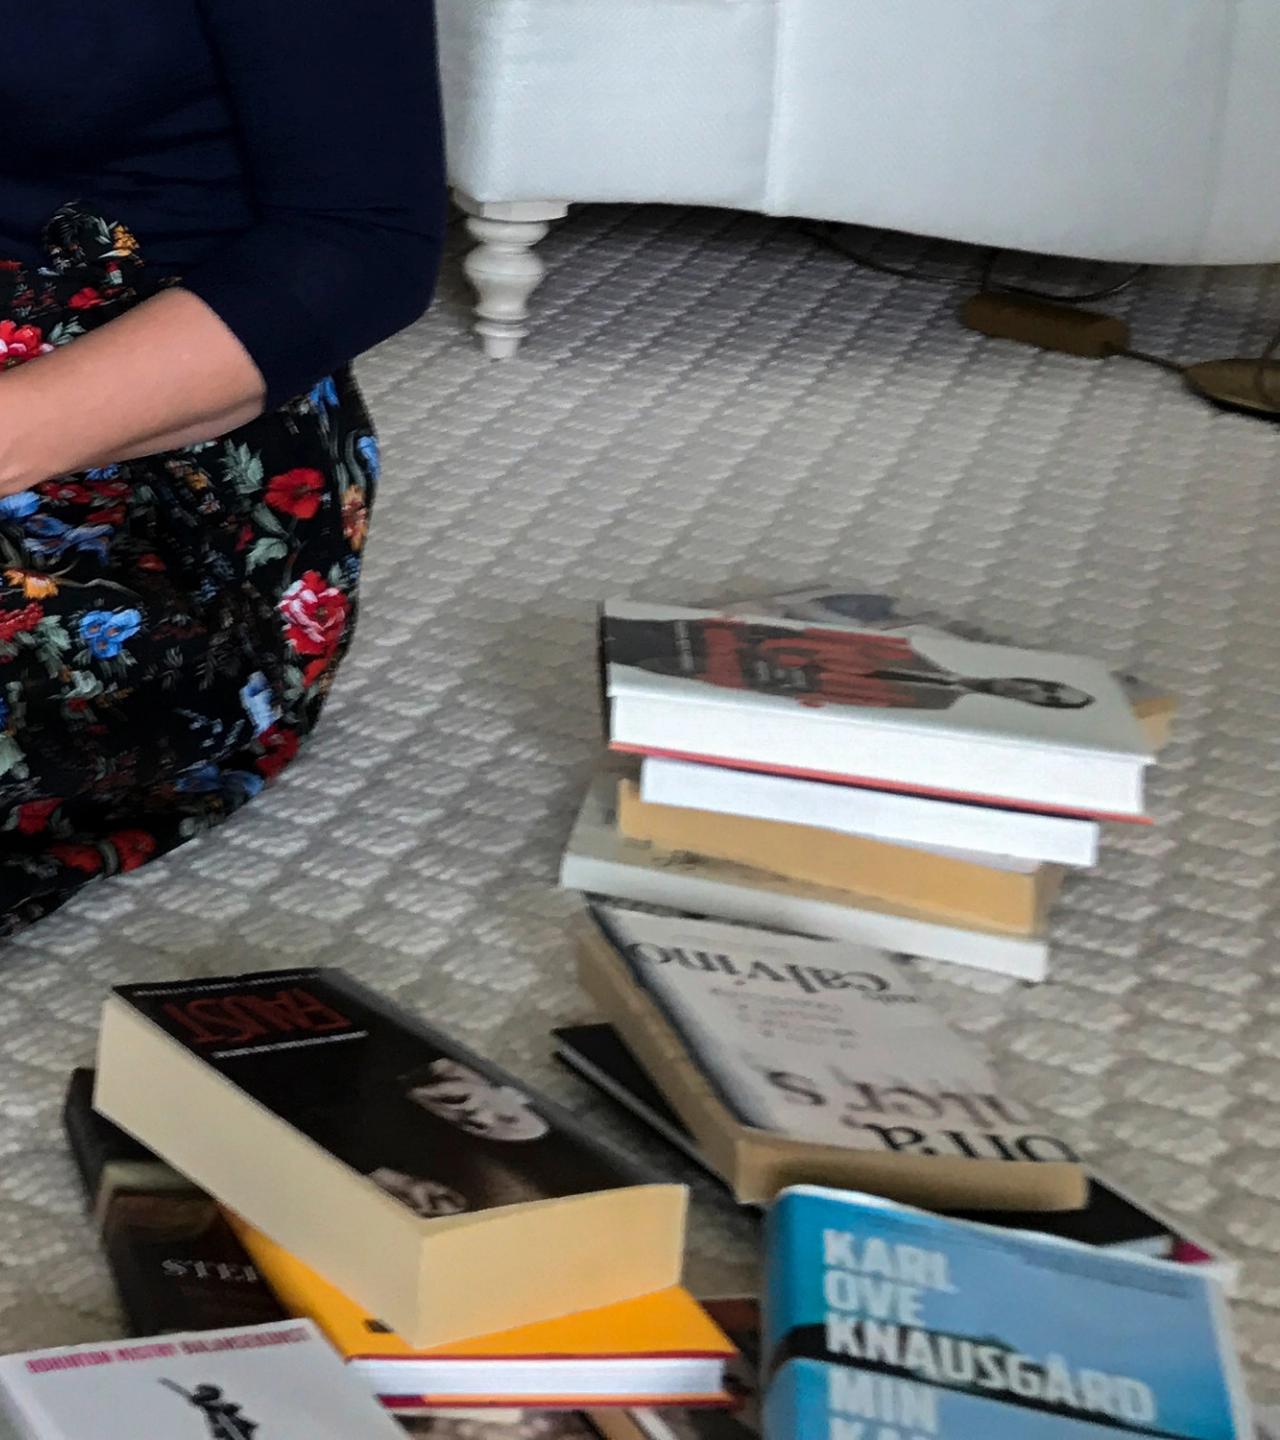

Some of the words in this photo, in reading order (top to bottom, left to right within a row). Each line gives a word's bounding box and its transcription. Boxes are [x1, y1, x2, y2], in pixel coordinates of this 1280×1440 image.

[626, 942, 889, 993] calvino
[162, 989, 352, 1044] FAUST
[822, 1229, 961, 1295] KARL
[824, 1269, 925, 1327] OVE
[25, 1349, 112, 1374] ROHINTON
[116, 1342, 178, 1363] MISTRY
[825, 1309, 1157, 1423] KNAUSGÅRD
[828, 1366, 938, 1434] MIN
